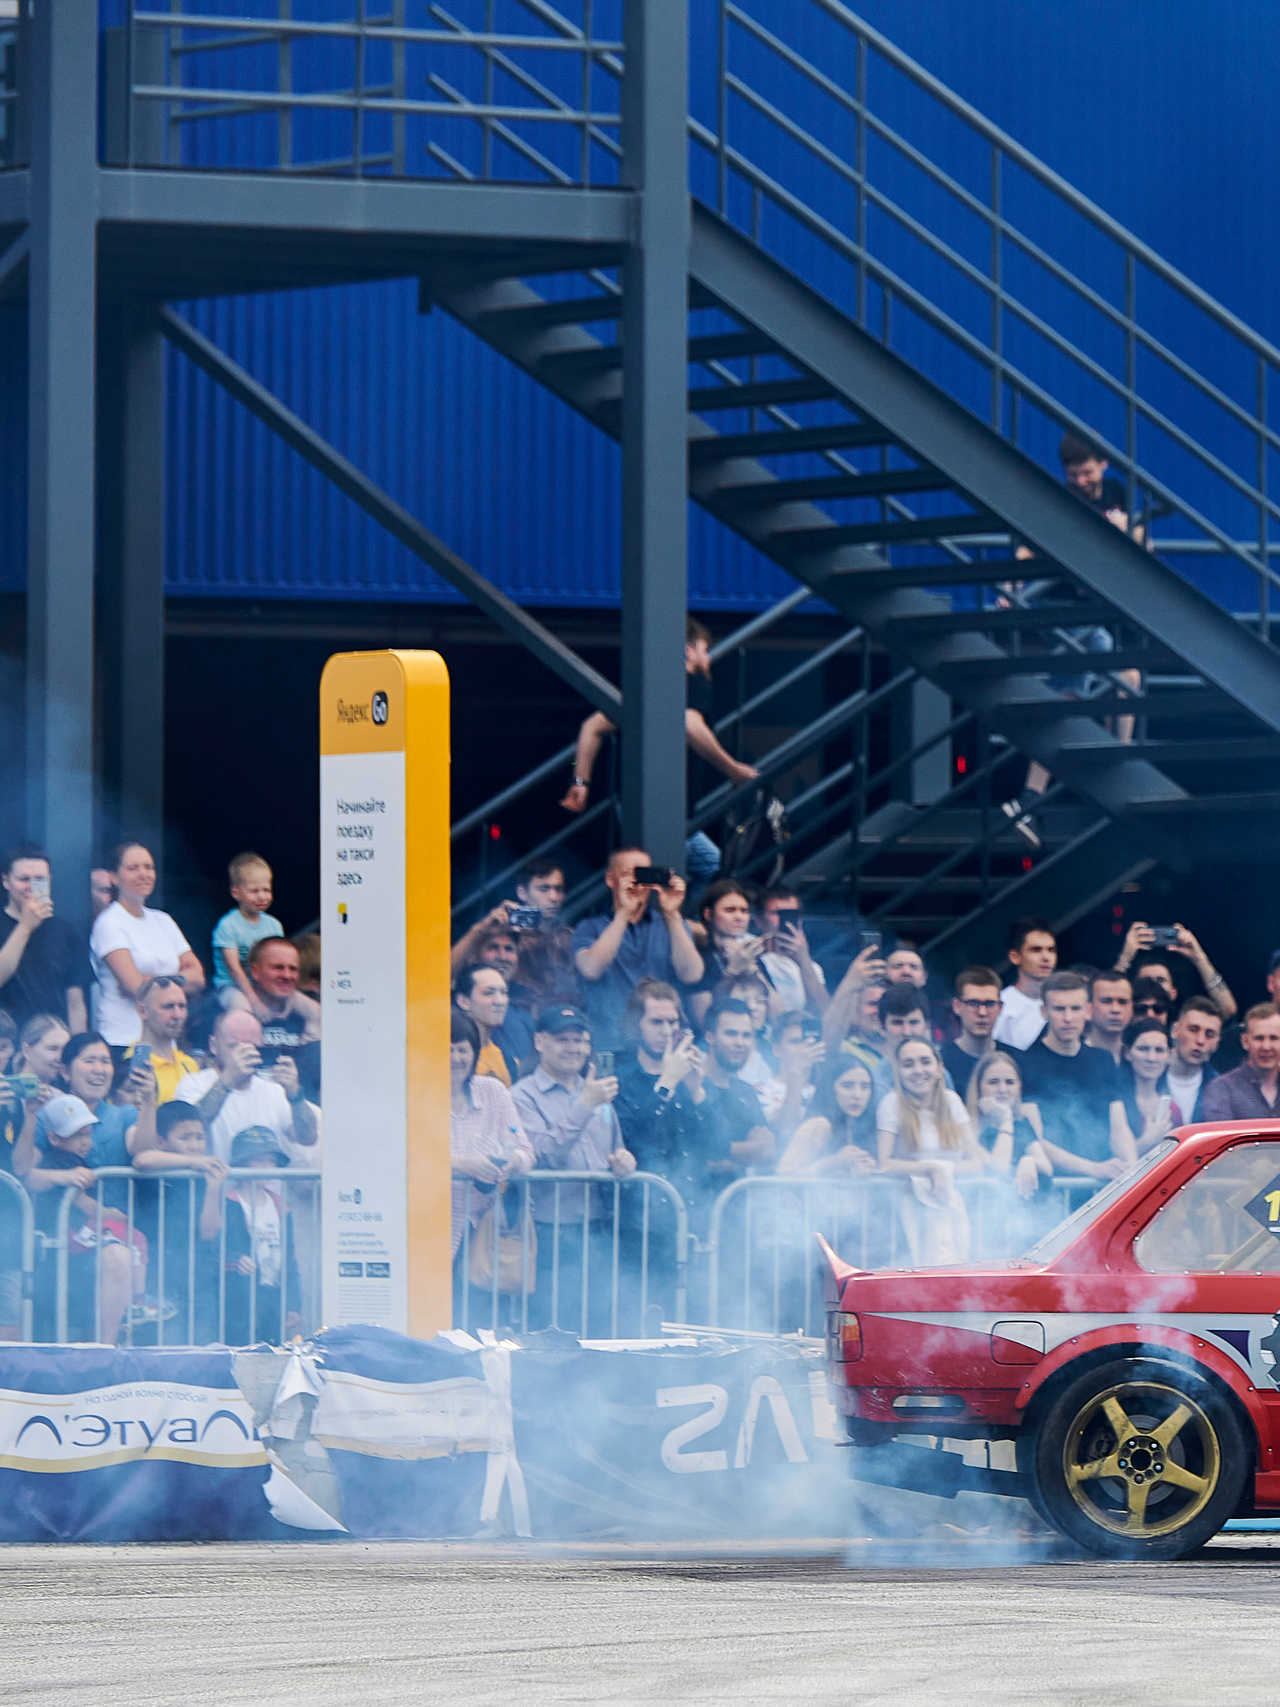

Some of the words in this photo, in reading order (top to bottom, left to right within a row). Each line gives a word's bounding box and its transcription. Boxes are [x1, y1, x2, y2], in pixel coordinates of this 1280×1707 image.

[337, 797, 386, 814] Начинайте
[337, 825, 375, 840] поездку
[337, 849, 348, 861] на
[349, 849, 375, 861] такси
[337, 872, 363, 886] здесь
